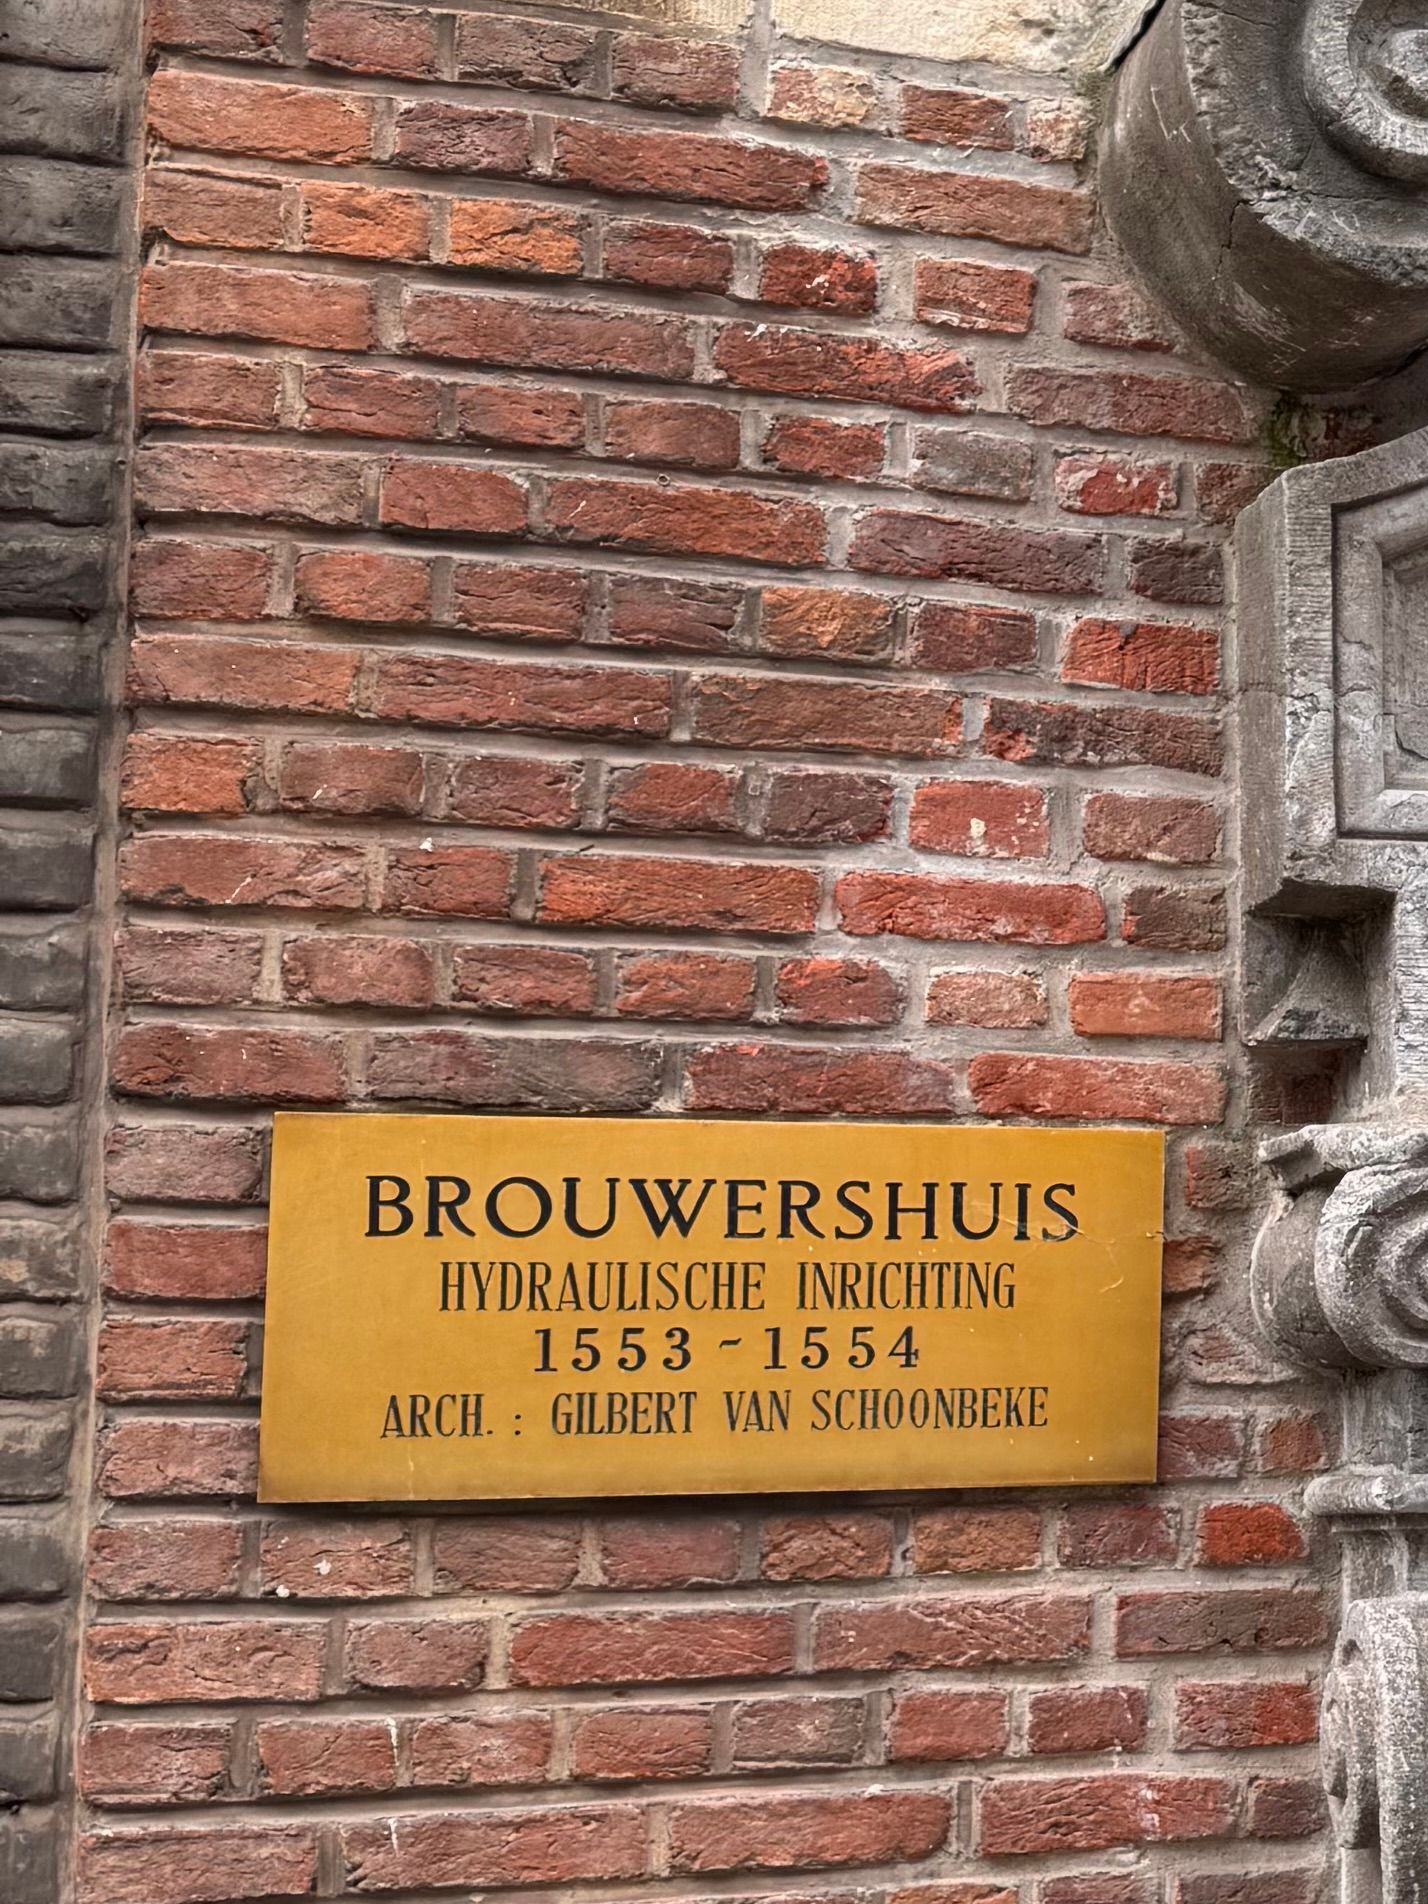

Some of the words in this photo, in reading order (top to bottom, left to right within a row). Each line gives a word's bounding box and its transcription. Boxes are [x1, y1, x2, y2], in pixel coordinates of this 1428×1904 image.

[364, 1175, 1080, 1243] BROUWERSHUIS
[438, 1260, 767, 1313] HYDRAULISCHE
[797, 1261, 1017, 1311] INRICHTING
[533, 1326, 692, 1373] 1553
[763, 1325, 920, 1371] 1554
[379, 1393, 495, 1439] ARCH.
[551, 1391, 698, 1437] GILBERT
[722, 1389, 791, 1435] VAN
[810, 1386, 1050, 1432] SCHOONBEKE
